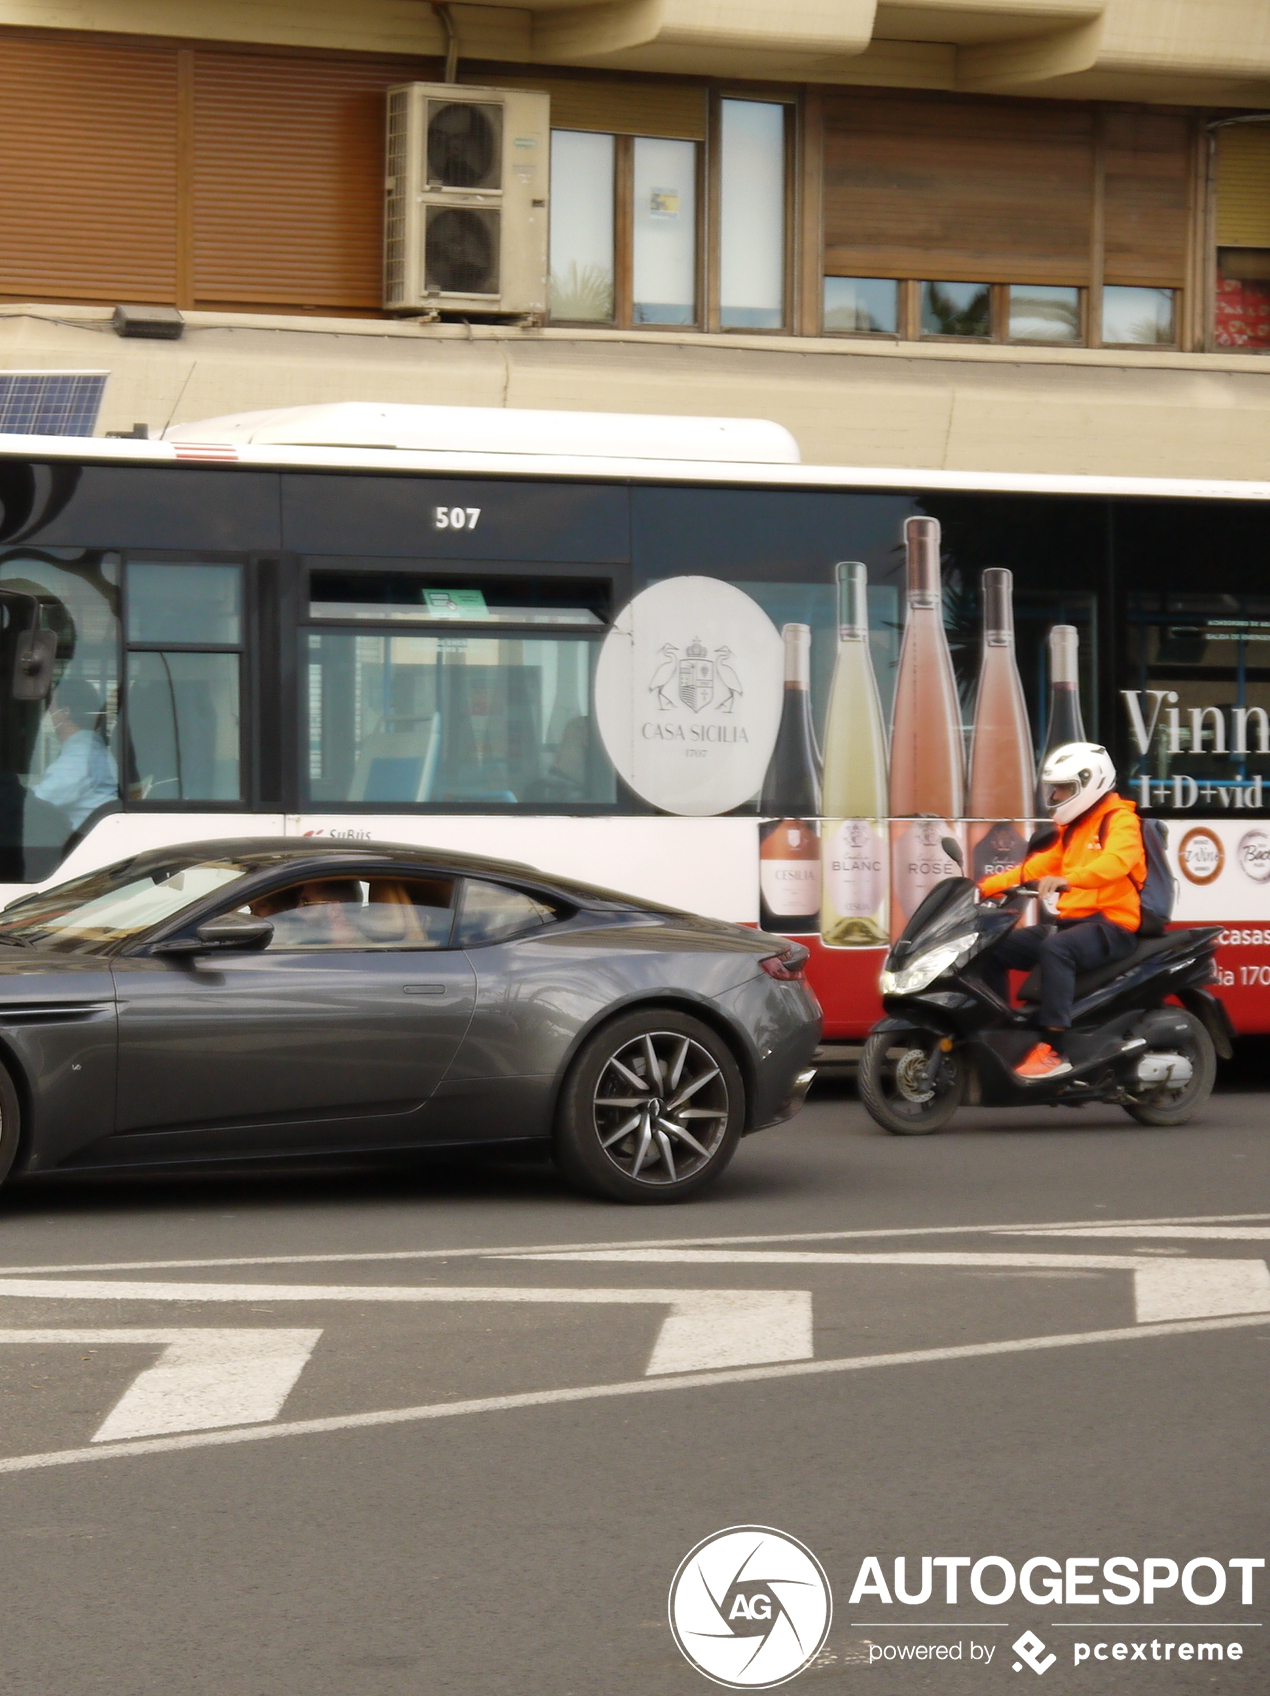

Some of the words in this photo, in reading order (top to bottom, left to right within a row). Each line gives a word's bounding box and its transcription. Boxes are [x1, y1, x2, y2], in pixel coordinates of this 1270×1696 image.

[435, 507, 481, 529] 507
[1120, 690, 1270, 755] Vinn
[642, 722, 686, 742] CASA
[691, 723, 749, 744] SICILIA
[685, 749, 708, 758] 1707
[832, 861, 882, 871] BLANC
[908, 860, 953, 875] ROSÉ
[775, 869, 815, 881] CESILIA
